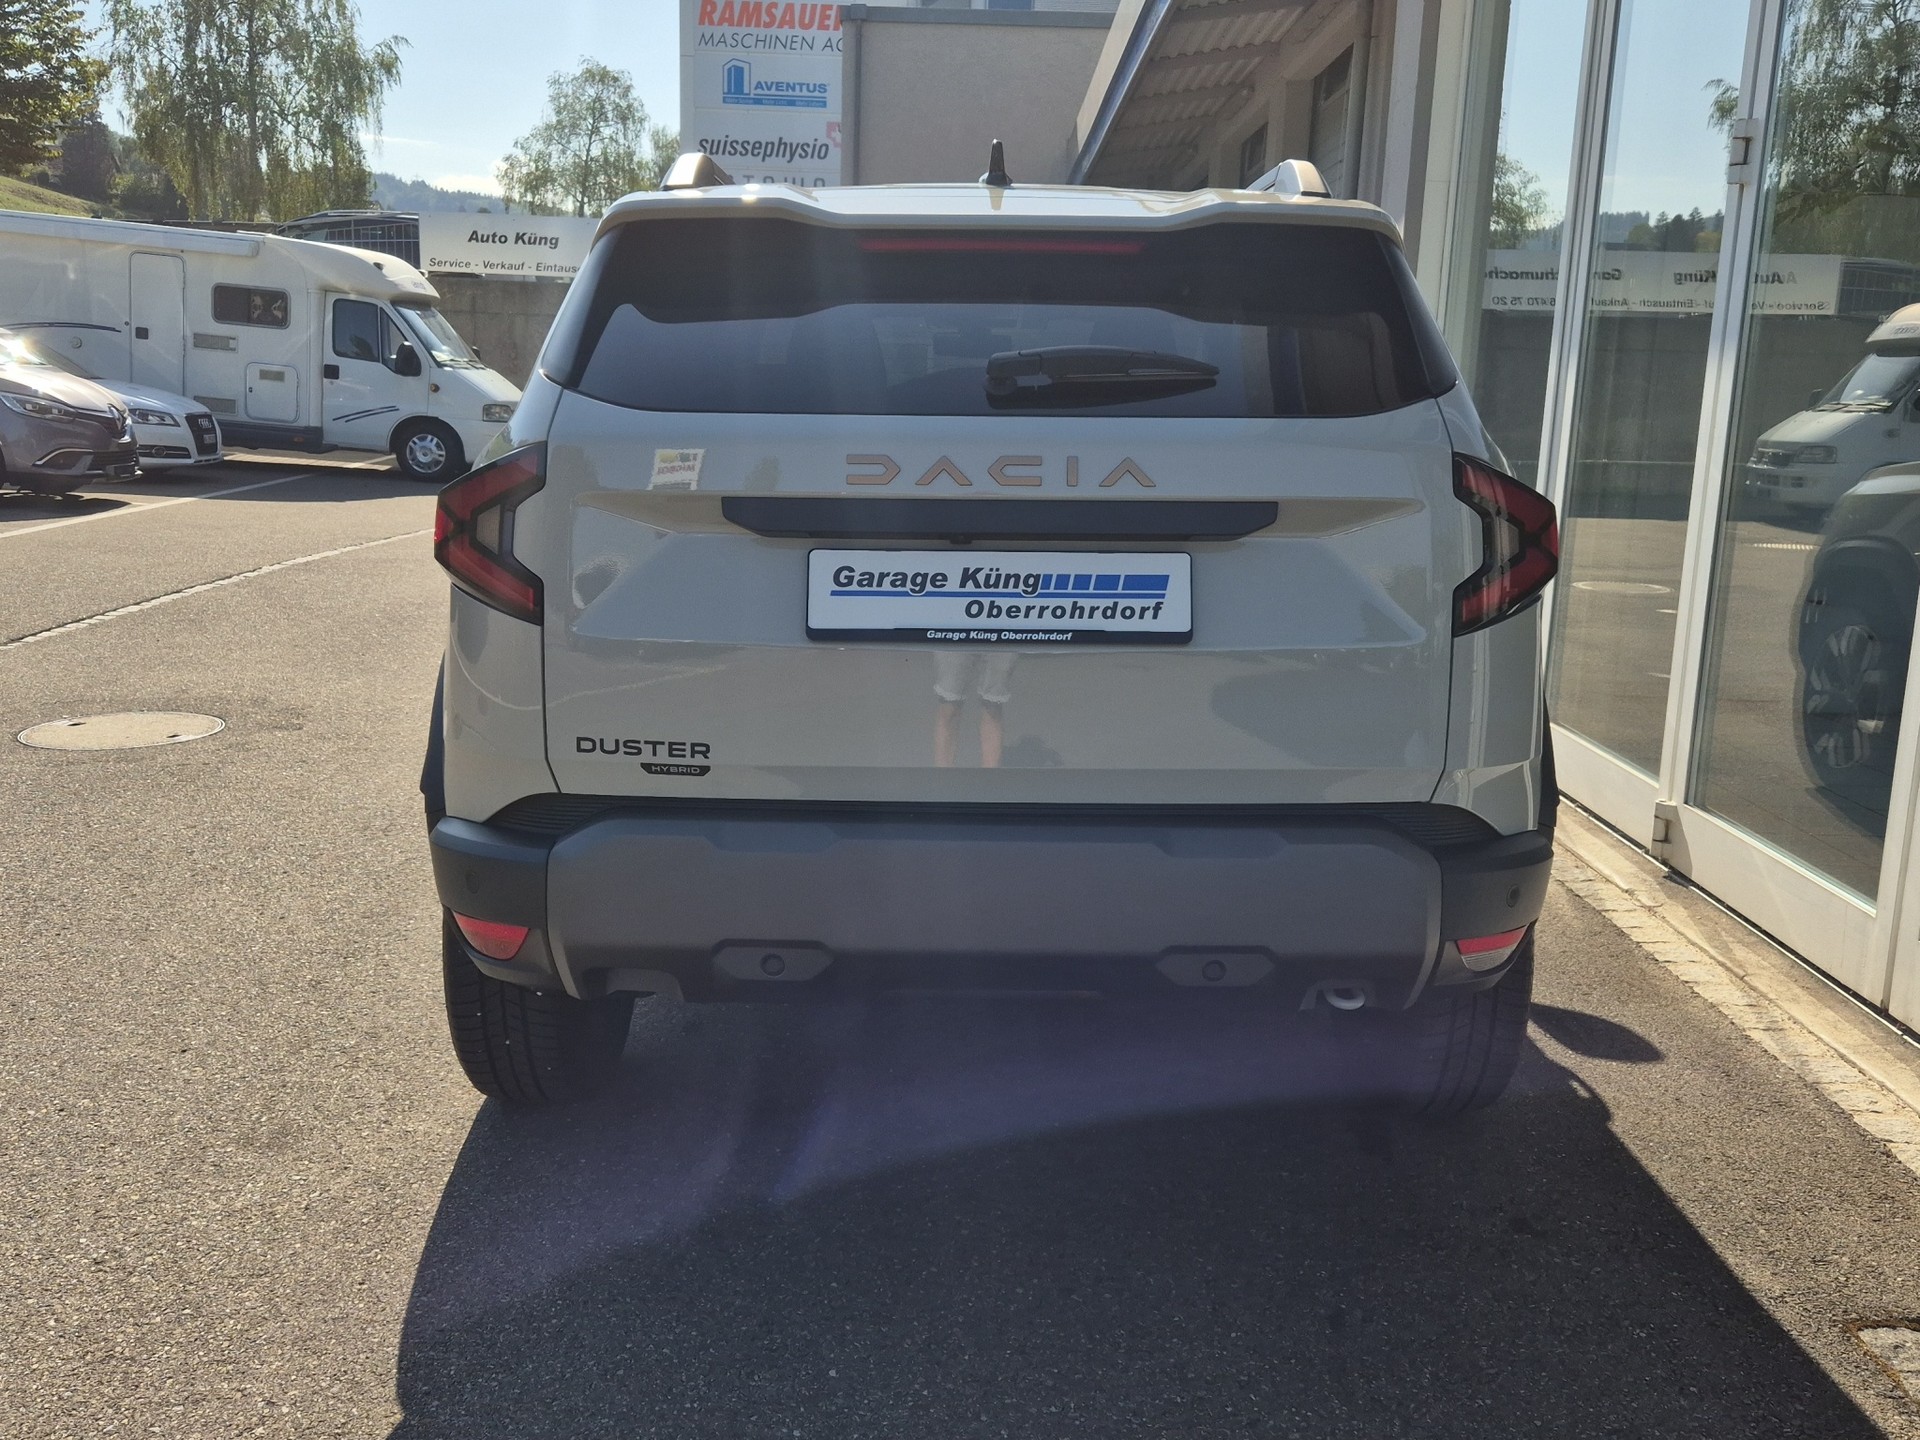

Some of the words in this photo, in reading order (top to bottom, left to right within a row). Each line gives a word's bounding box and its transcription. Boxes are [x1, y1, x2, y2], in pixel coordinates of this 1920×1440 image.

[698, 32, 814, 50] MASCHINEN
[754, 81, 828, 94] AVENTUS
[697, 135, 829, 163] suissephysio
[467, 230, 508, 244] Auto
[514, 232, 559, 249] Küng
[429, 258, 471, 269] Service
[483, 260, 525, 271] Verkauf
[846, 454, 1156, 487] DACIA
[832, 565, 948, 595] Garage
[959, 566, 1042, 595] Küng
[965, 600, 1164, 620] Oberrohrdorf
[926, 630, 967, 642] Garage
[969, 630, 998, 642] Küng
[1000, 631, 1073, 642] Oberrohrdorf
[576, 737, 711, 759] DUSTER
[651, 765, 701, 774] HYBRID
